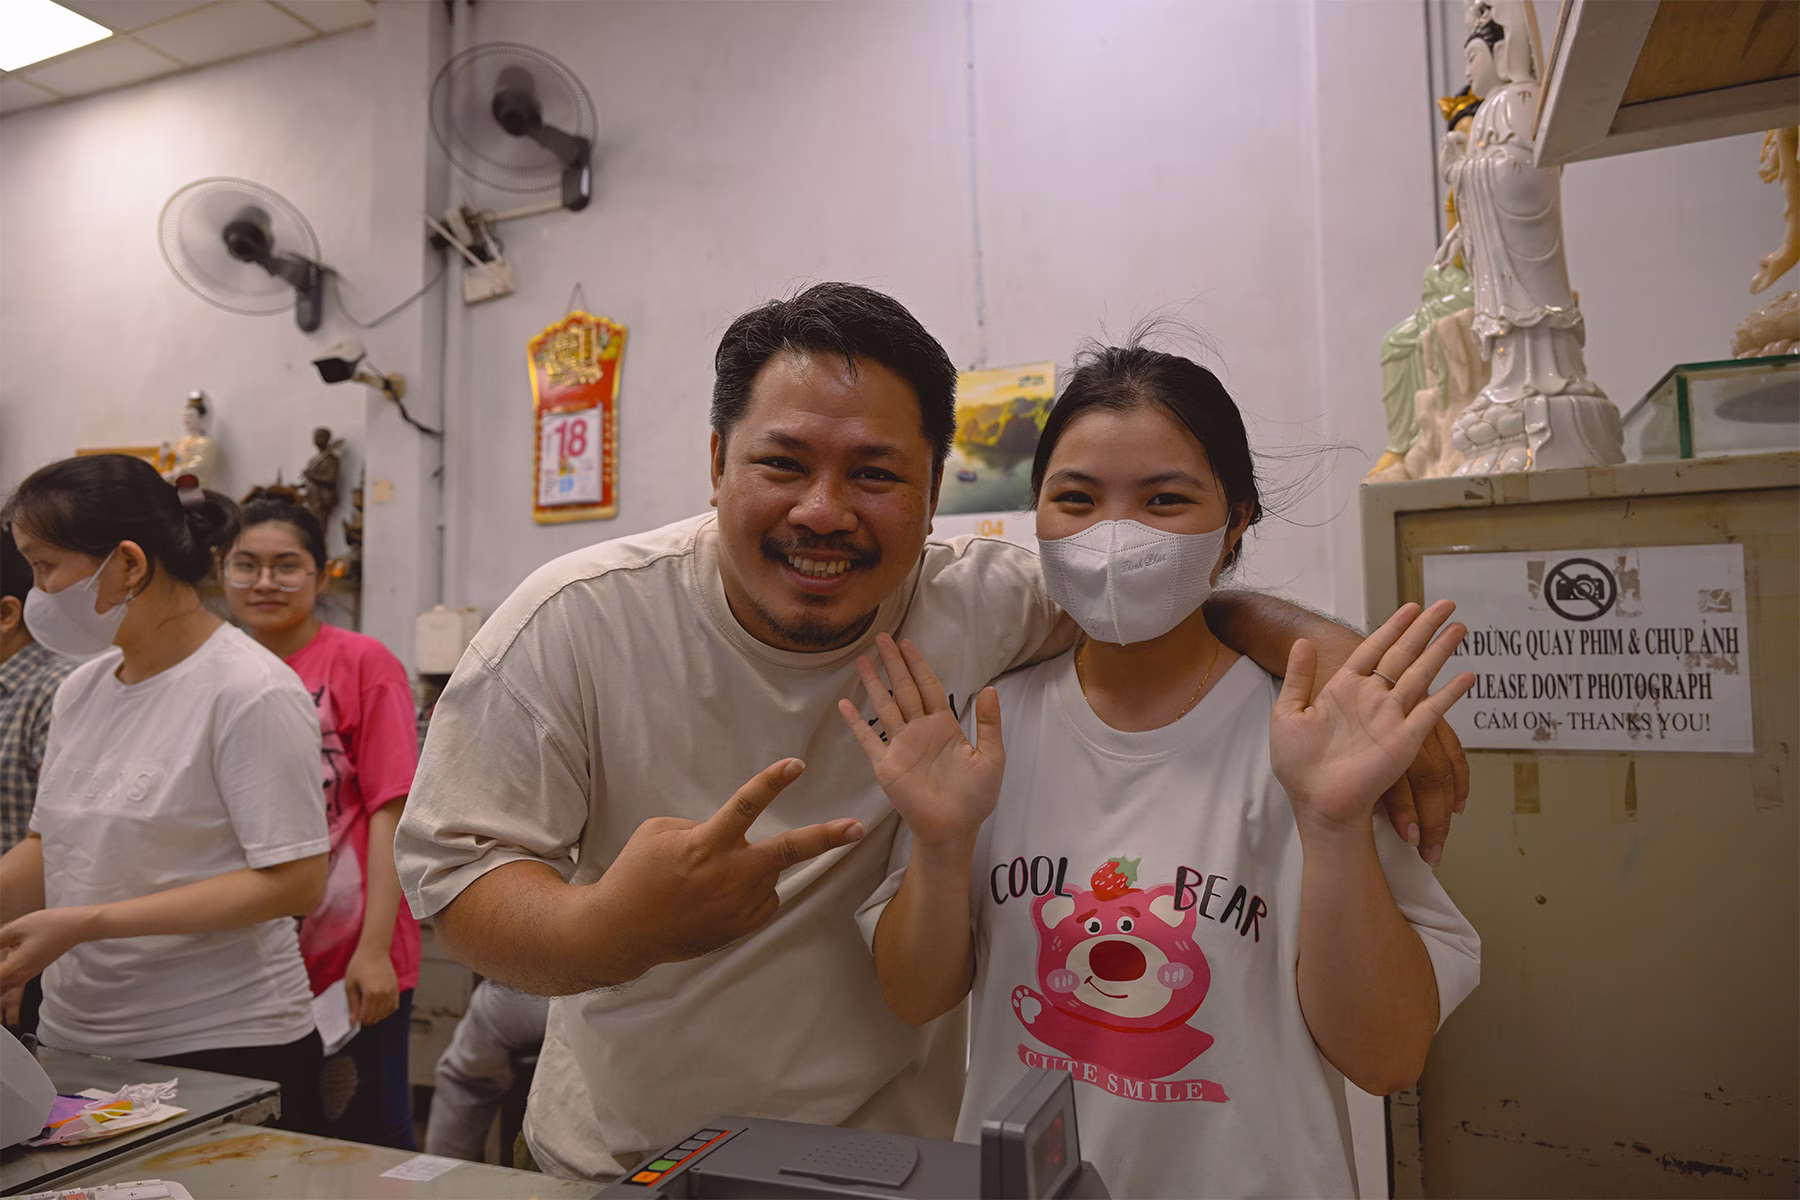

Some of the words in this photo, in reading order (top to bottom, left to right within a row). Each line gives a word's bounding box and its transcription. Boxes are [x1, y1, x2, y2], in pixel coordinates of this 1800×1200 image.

[554, 418, 588, 457] 18
[980, 519, 1004, 537] 04
[1526, 629, 1579, 660] QUAY
[1580, 628, 1624, 655] PHIM
[1628, 627, 1641, 655] &
[1645, 627, 1694, 661] CHỤP
[1700, 619, 1740, 655] ẢNH
[1533, 673, 1584, 700] DON'T
[1587, 673, 1714, 700] PHOTOGRAPH
[1567, 711, 1652, 731] THANKS
[1656, 712, 1711, 732] YOU!
[990, 855, 1074, 905] COOL
[1173, 865, 1268, 943] BEAR
[1025, 1050, 1098, 1083] CUTE
[1107, 1073, 1204, 1100] SMILE
